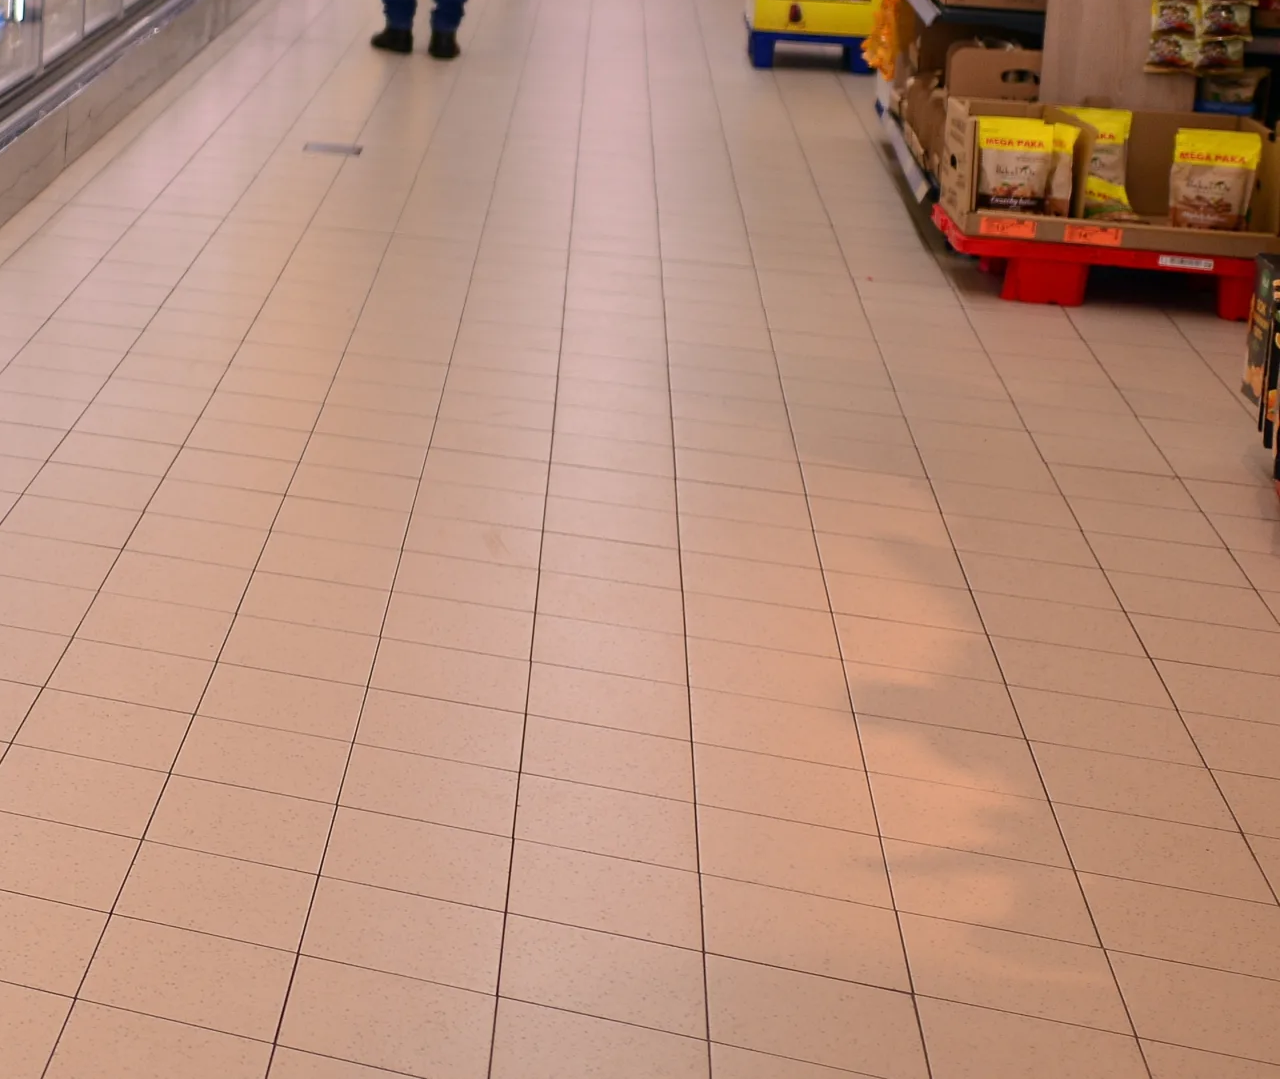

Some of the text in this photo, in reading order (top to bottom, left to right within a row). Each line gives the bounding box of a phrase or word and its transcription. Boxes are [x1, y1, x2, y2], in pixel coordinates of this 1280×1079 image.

[986, 138, 1044, 148] MEGA PAKA
[1179, 151, 1247, 164] MEGA PAKA
